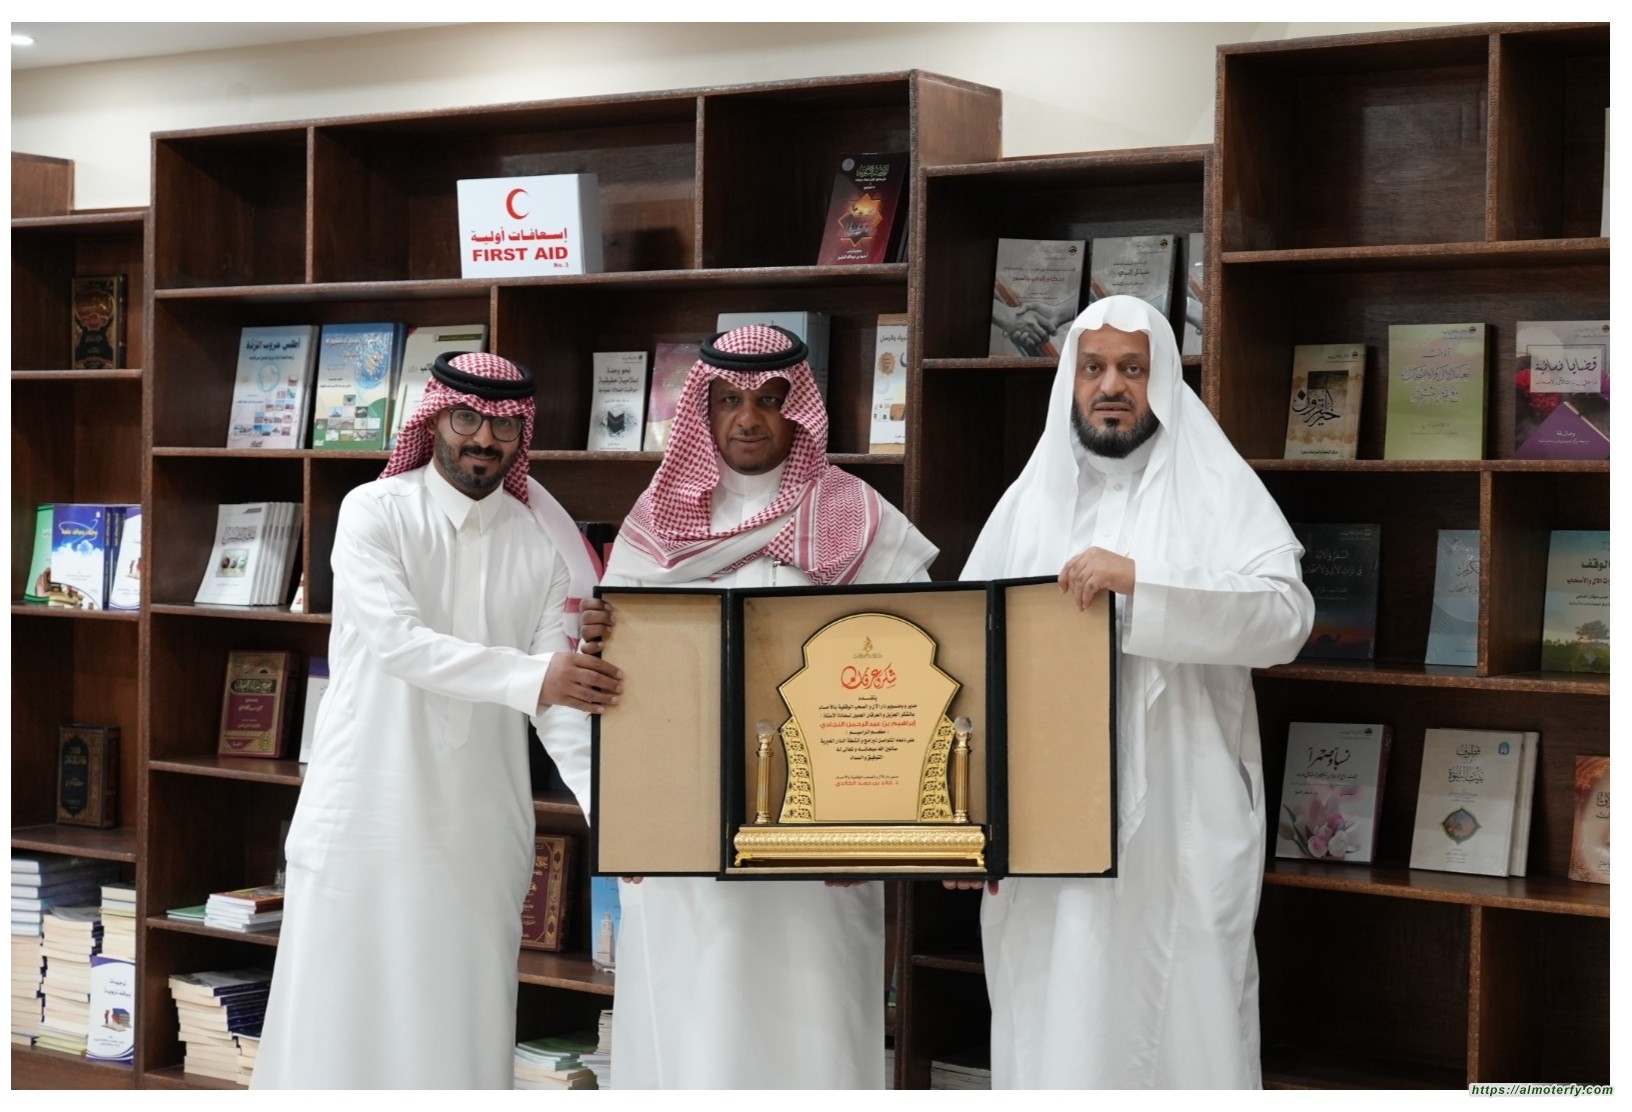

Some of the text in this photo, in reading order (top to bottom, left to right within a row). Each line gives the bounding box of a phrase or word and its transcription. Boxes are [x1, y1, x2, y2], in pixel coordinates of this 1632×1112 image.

[471, 226, 568, 245] إسعافات أولية
[472, 246, 569, 262] FIRST AID
[1535, 356, 1598, 375] قضايا نسائية
[891, 720, 916, 728] إبراهيم
